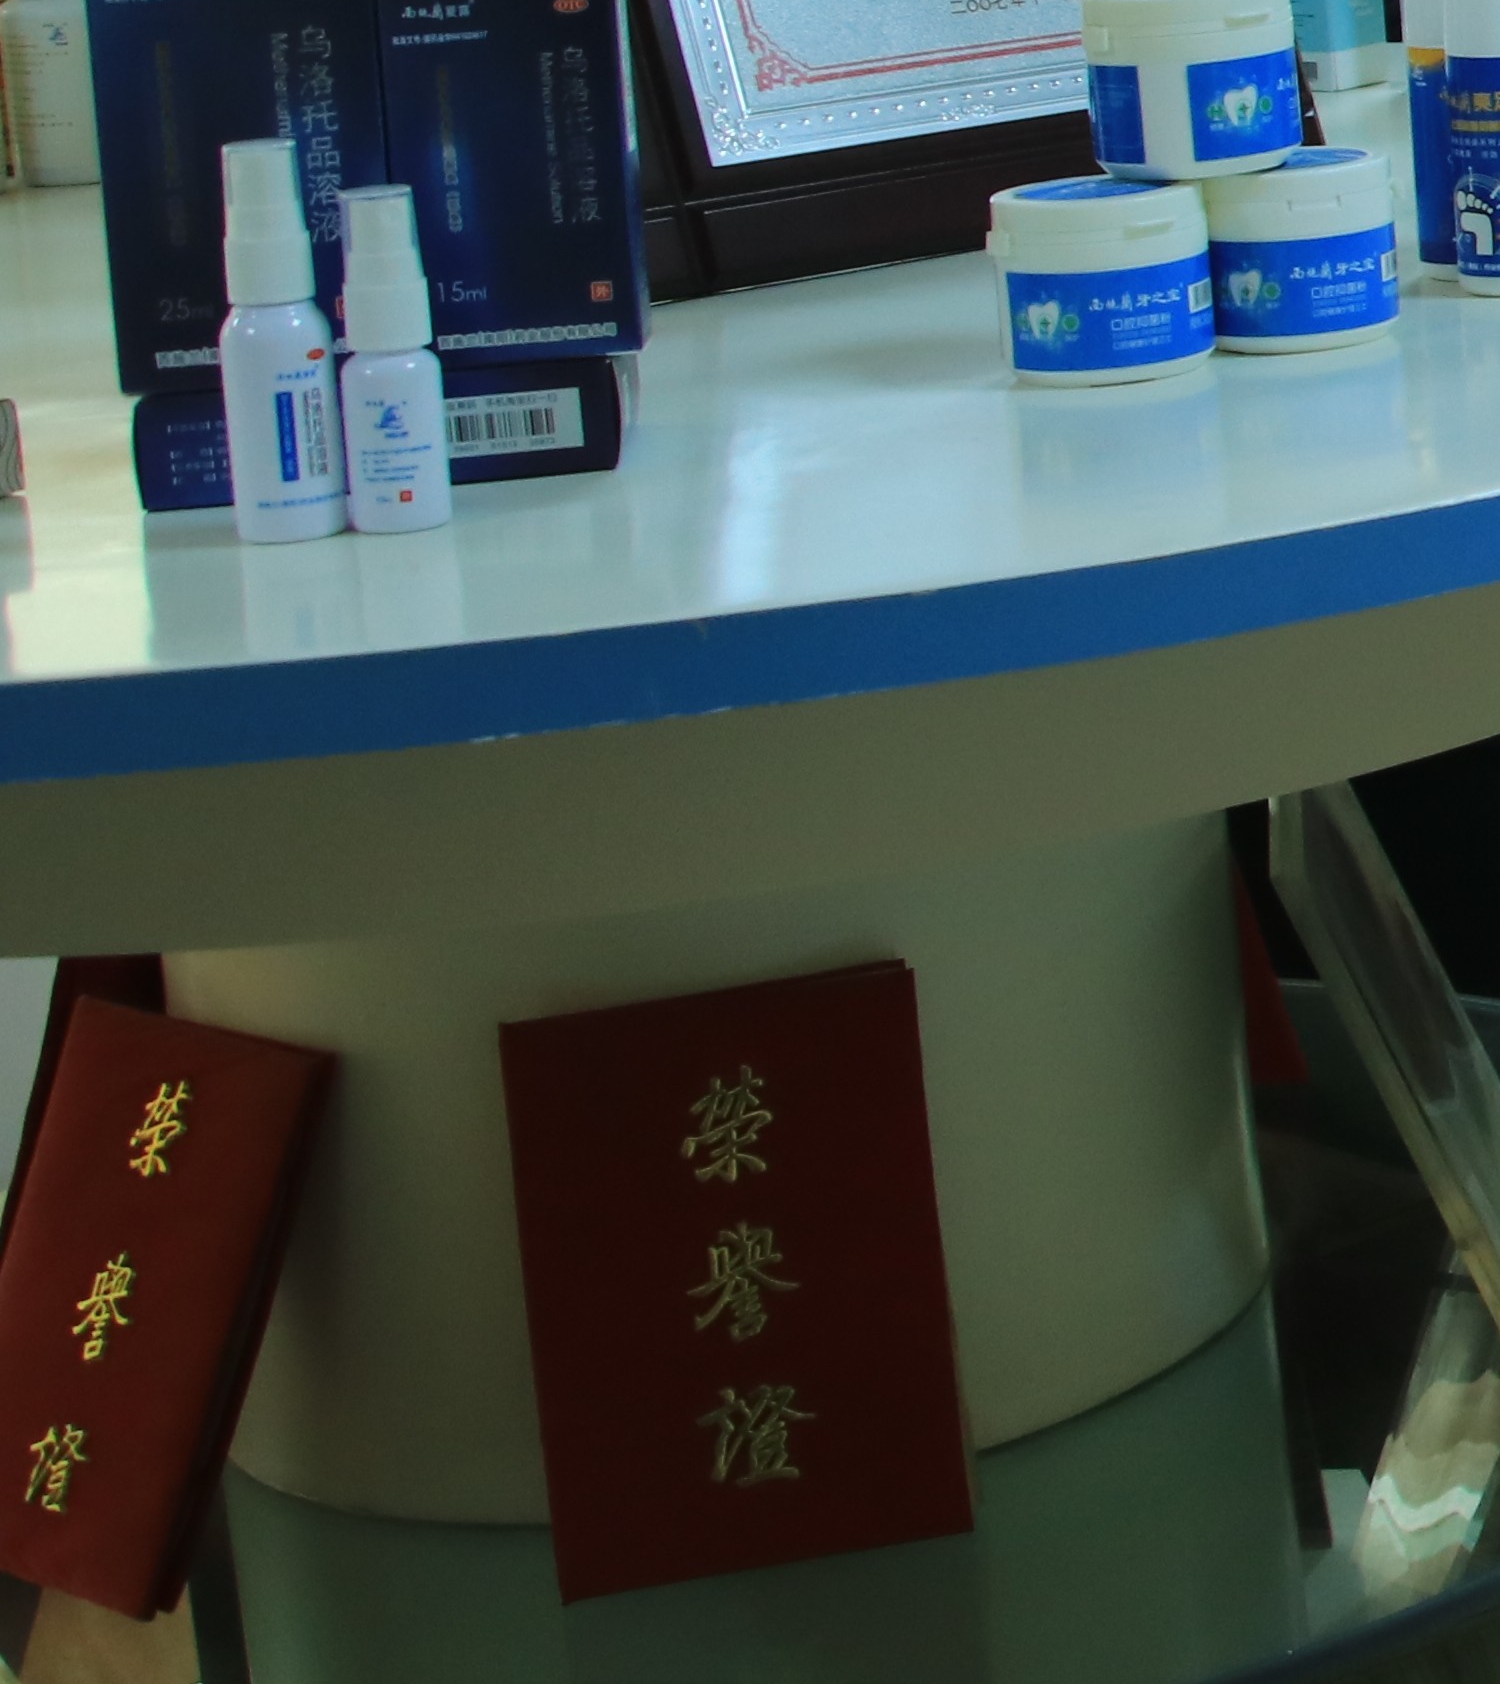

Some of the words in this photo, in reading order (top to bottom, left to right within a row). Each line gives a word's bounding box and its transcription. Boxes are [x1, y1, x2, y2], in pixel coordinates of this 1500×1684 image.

[298, 24, 343, 244] 乌洛托品溶液
[436, 280, 488, 306] 15ml
